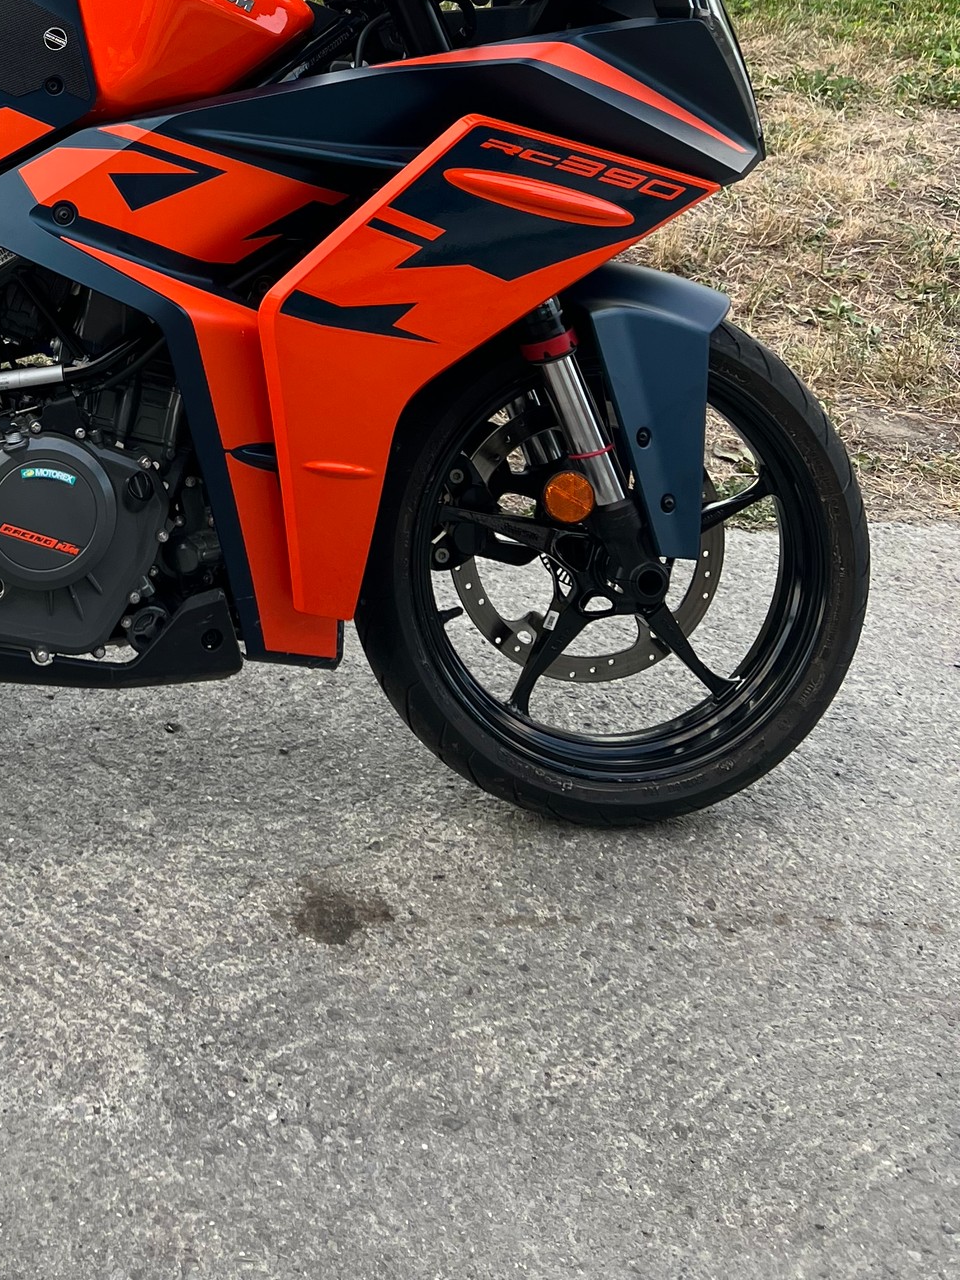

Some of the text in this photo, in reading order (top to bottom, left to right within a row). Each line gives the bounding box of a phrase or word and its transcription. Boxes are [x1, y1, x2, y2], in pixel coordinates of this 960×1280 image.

[480, 138, 687, 201] RC390
[34, 468, 74, 485] MOTOREX
[3, 525, 81, 555] RACING KTM
